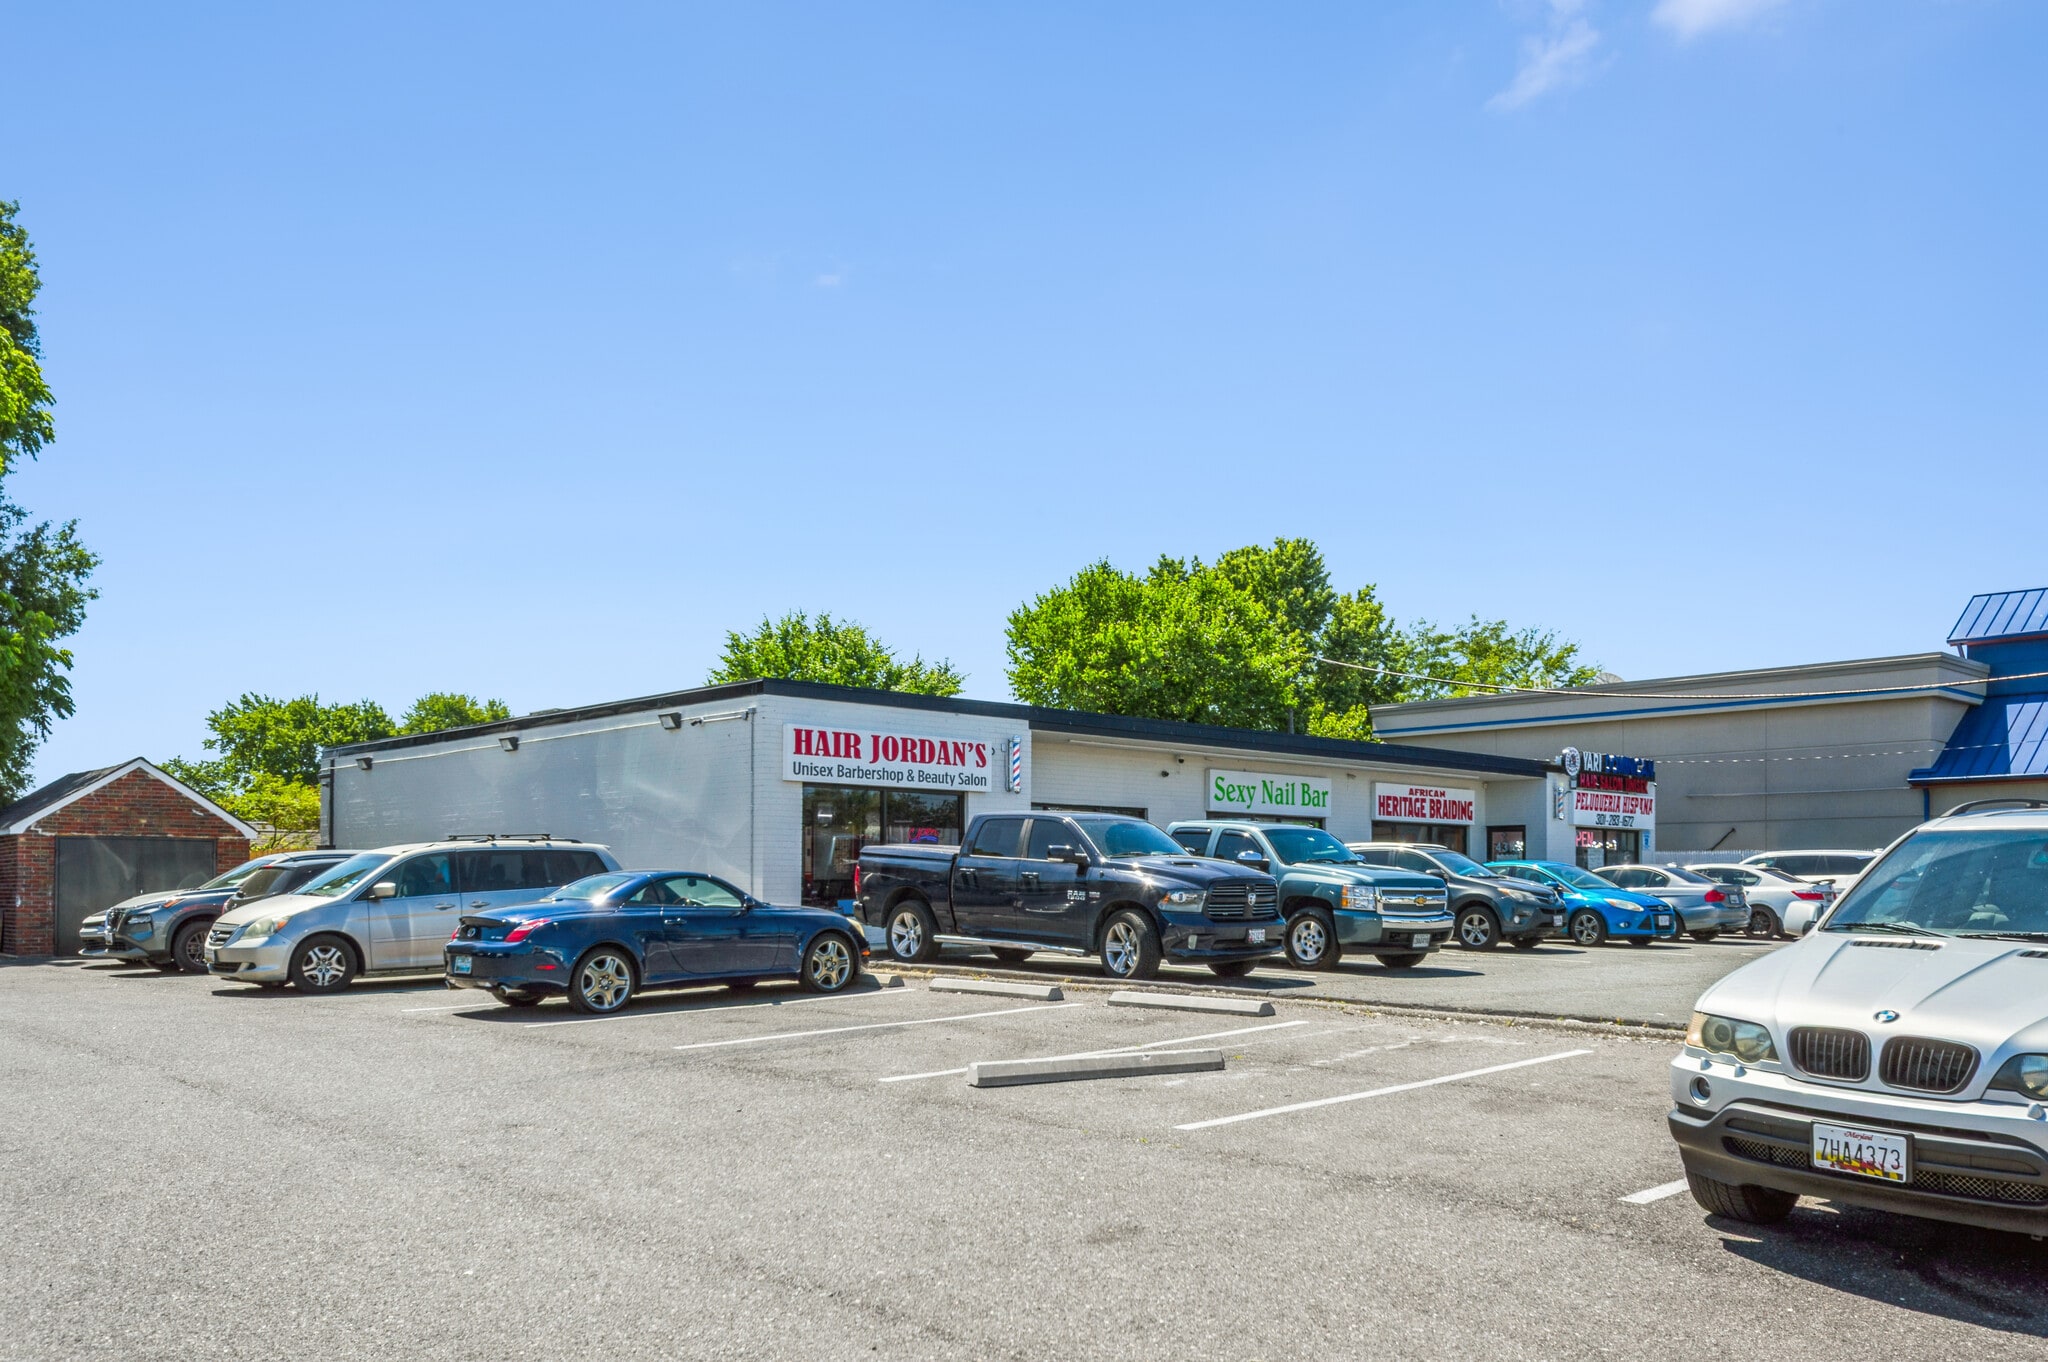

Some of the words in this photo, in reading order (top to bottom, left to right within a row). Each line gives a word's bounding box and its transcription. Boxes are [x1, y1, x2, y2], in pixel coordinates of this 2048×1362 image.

[793, 728, 862, 759] HAIR
[869, 734, 987, 768] JORDAN'S
[1582, 751, 1602, 772] YARI
[793, 761, 833, 777] Unisex
[837, 764, 904, 783] Barbershop
[906, 770, 915, 782] &
[918, 771, 955, 786] Beauty
[958, 772, 987, 787] Salon
[1214, 776, 1256, 809] Sexy
[1261, 780, 1296, 805] Nail
[1300, 782, 1329, 807] Bar
[1408, 788, 1446, 798] AFRICAN
[1575, 792, 1621, 813] PELUQUERIA
[1622, 796, 1654, 815] HISPANA
[1378, 795, 1427, 818] HERITAGE
[1429, 798, 1473, 821] BRAIDING
[1575, 831, 1594, 848] PEN
[1844, 1131, 1873, 1141] Maryland
[1818, 1137, 1901, 1170] 7HA4373
